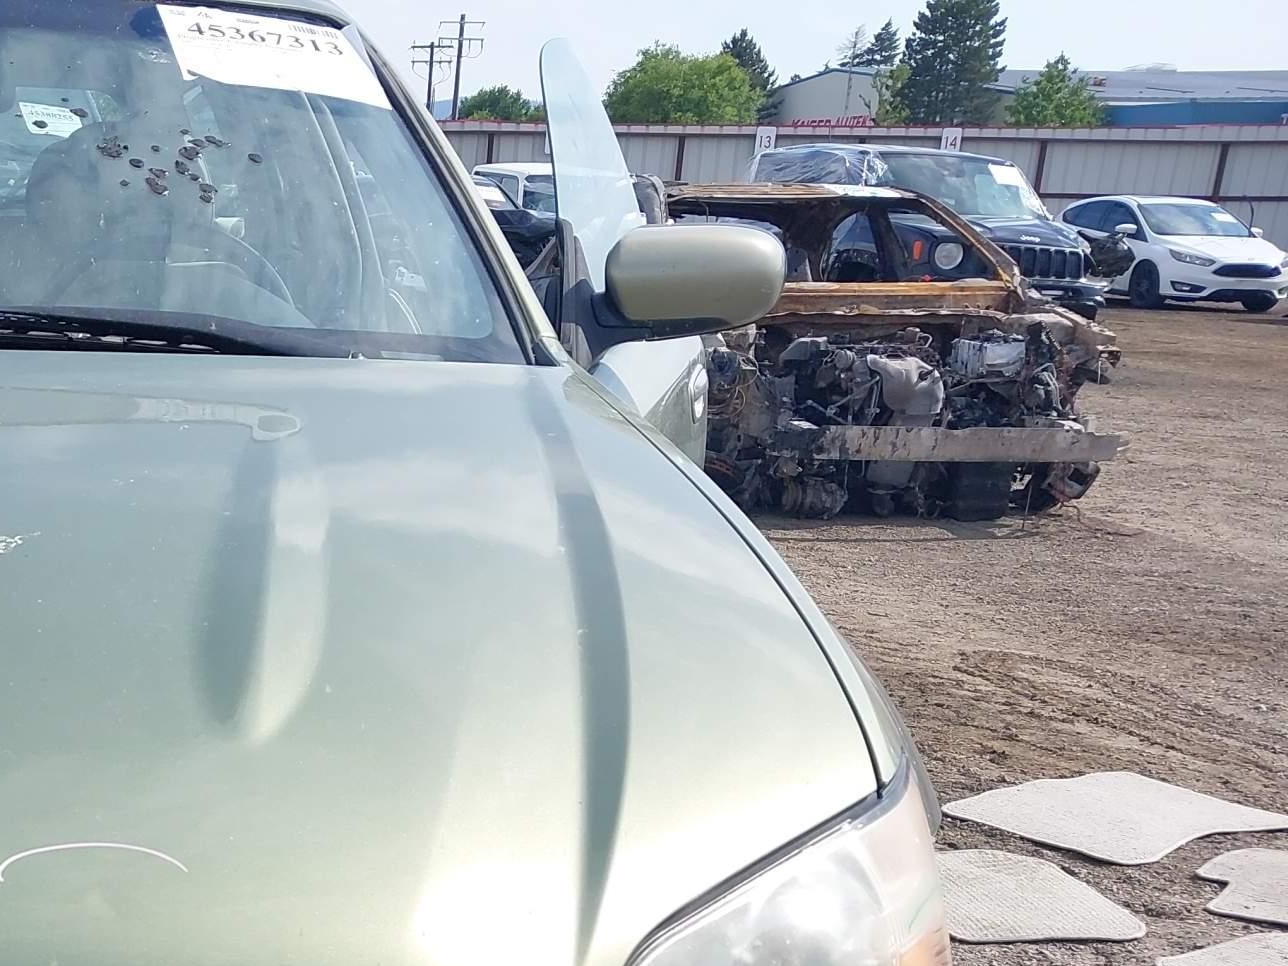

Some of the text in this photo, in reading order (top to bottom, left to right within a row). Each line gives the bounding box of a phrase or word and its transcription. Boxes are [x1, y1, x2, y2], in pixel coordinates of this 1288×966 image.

[187, 21, 344, 56] 45367313
[759, 135, 772, 149] 13
[943, 135, 958, 150] 14
